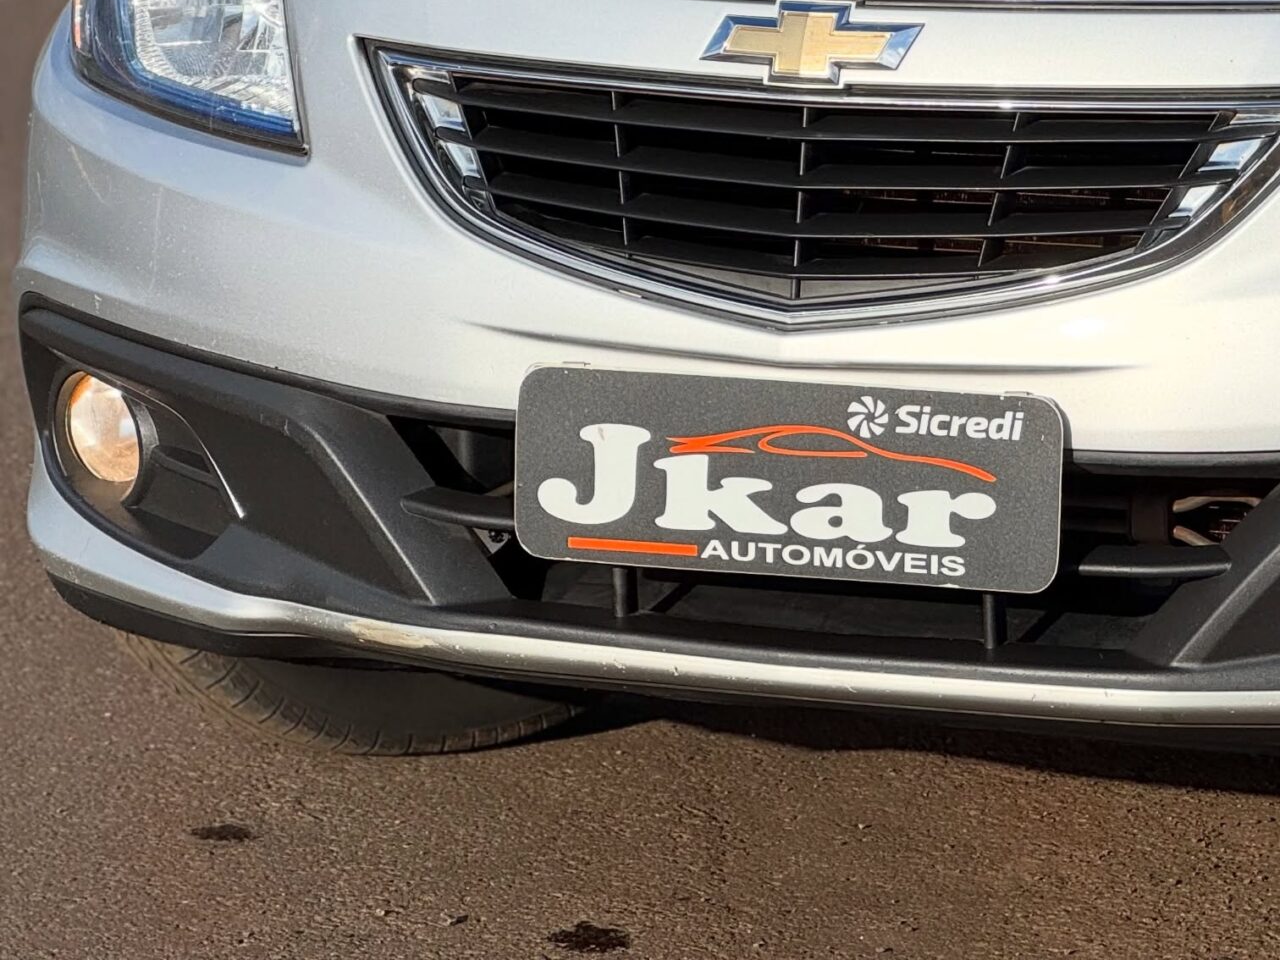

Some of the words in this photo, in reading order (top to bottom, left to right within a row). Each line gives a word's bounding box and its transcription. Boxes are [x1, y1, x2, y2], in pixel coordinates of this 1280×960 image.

[895, 403, 1024, 442] Sicredi
[536, 422, 997, 548] Jkar
[700, 539, 967, 578] AUTOMÓVEIS
